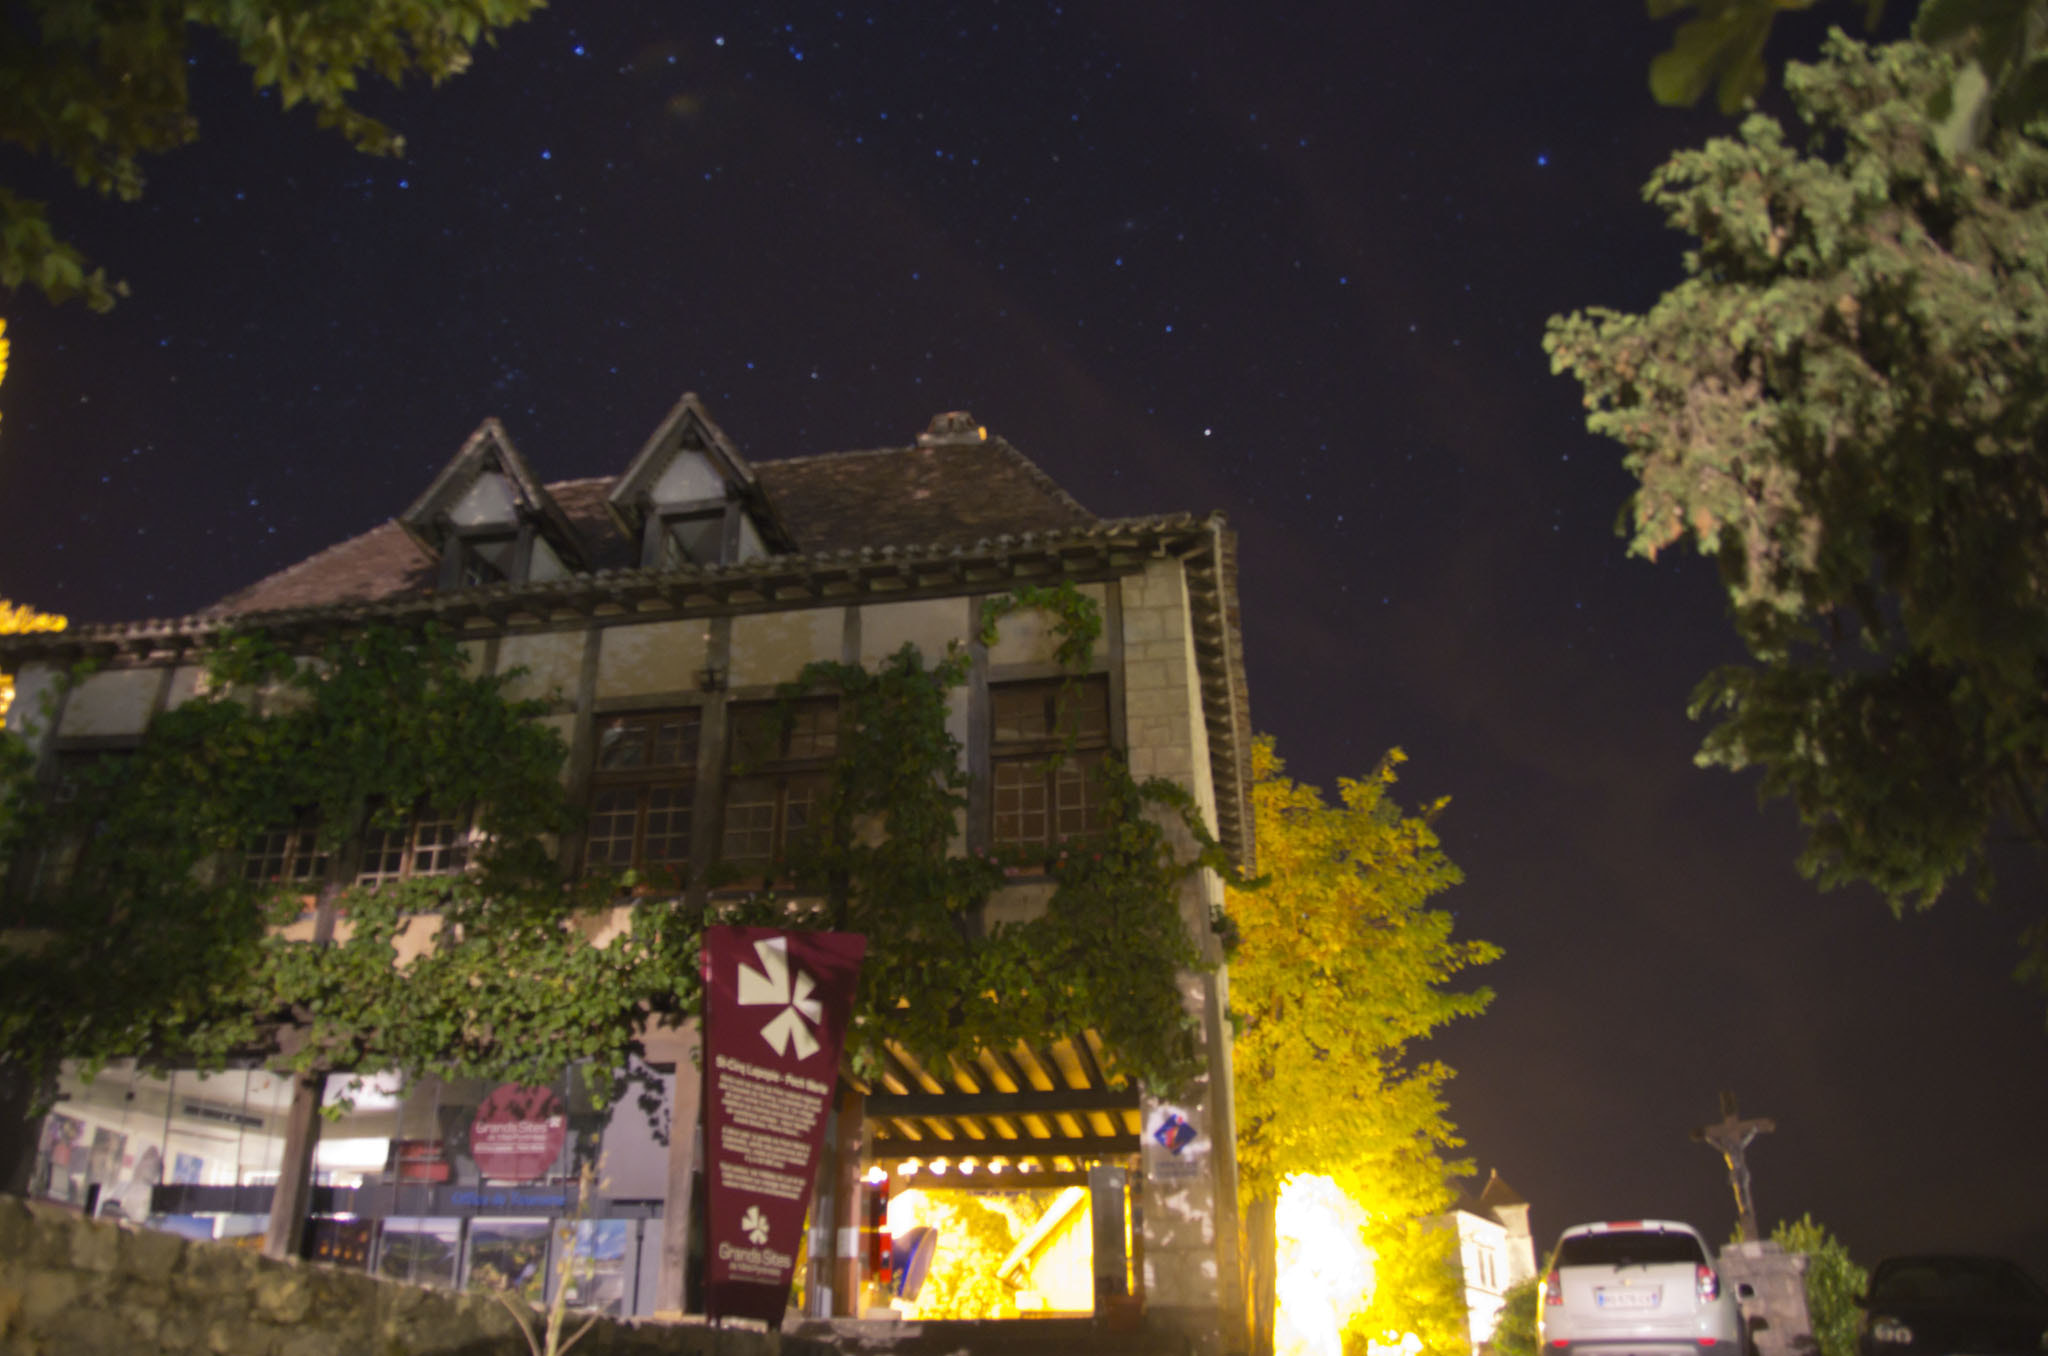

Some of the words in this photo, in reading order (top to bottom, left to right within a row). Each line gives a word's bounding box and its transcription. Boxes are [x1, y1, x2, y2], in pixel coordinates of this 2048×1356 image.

[475, 1120, 517, 1133] Grands
[519, 1120, 548, 1133] Sites
[718, 1241, 761, 1264] Grands
[762, 1249, 791, 1269] Sites
